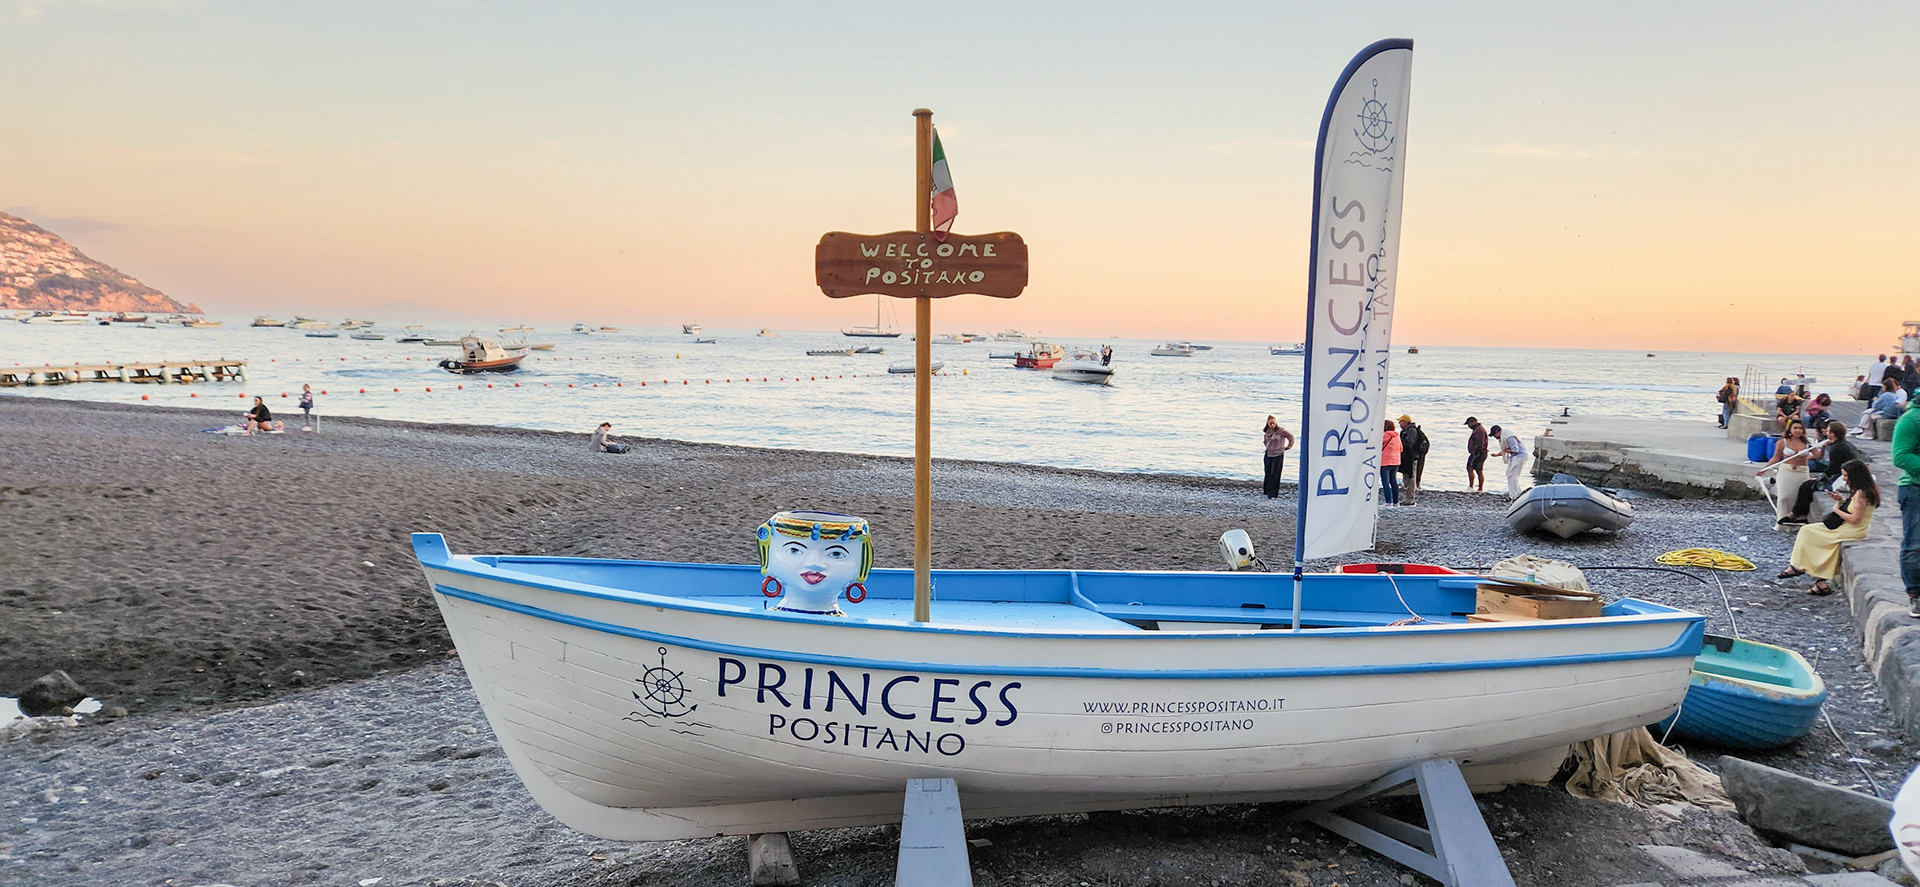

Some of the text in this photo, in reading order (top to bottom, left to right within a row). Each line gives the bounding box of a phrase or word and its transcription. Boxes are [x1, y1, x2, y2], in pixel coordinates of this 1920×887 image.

[860, 242, 997, 258] WELCOME
[905, 258, 933, 269] TO
[1373, 269, 1389, 321] TAXI
[1316, 196, 1365, 497] PRINCESS
[717, 657, 1022, 727] PRINCESS
[1083, 698, 1286, 714] WWW.PRINCESSPOSITANO.IT
[768, 713, 966, 757] POSITANO
[1116, 719, 1254, 734] PRINCESSPOSITANO
